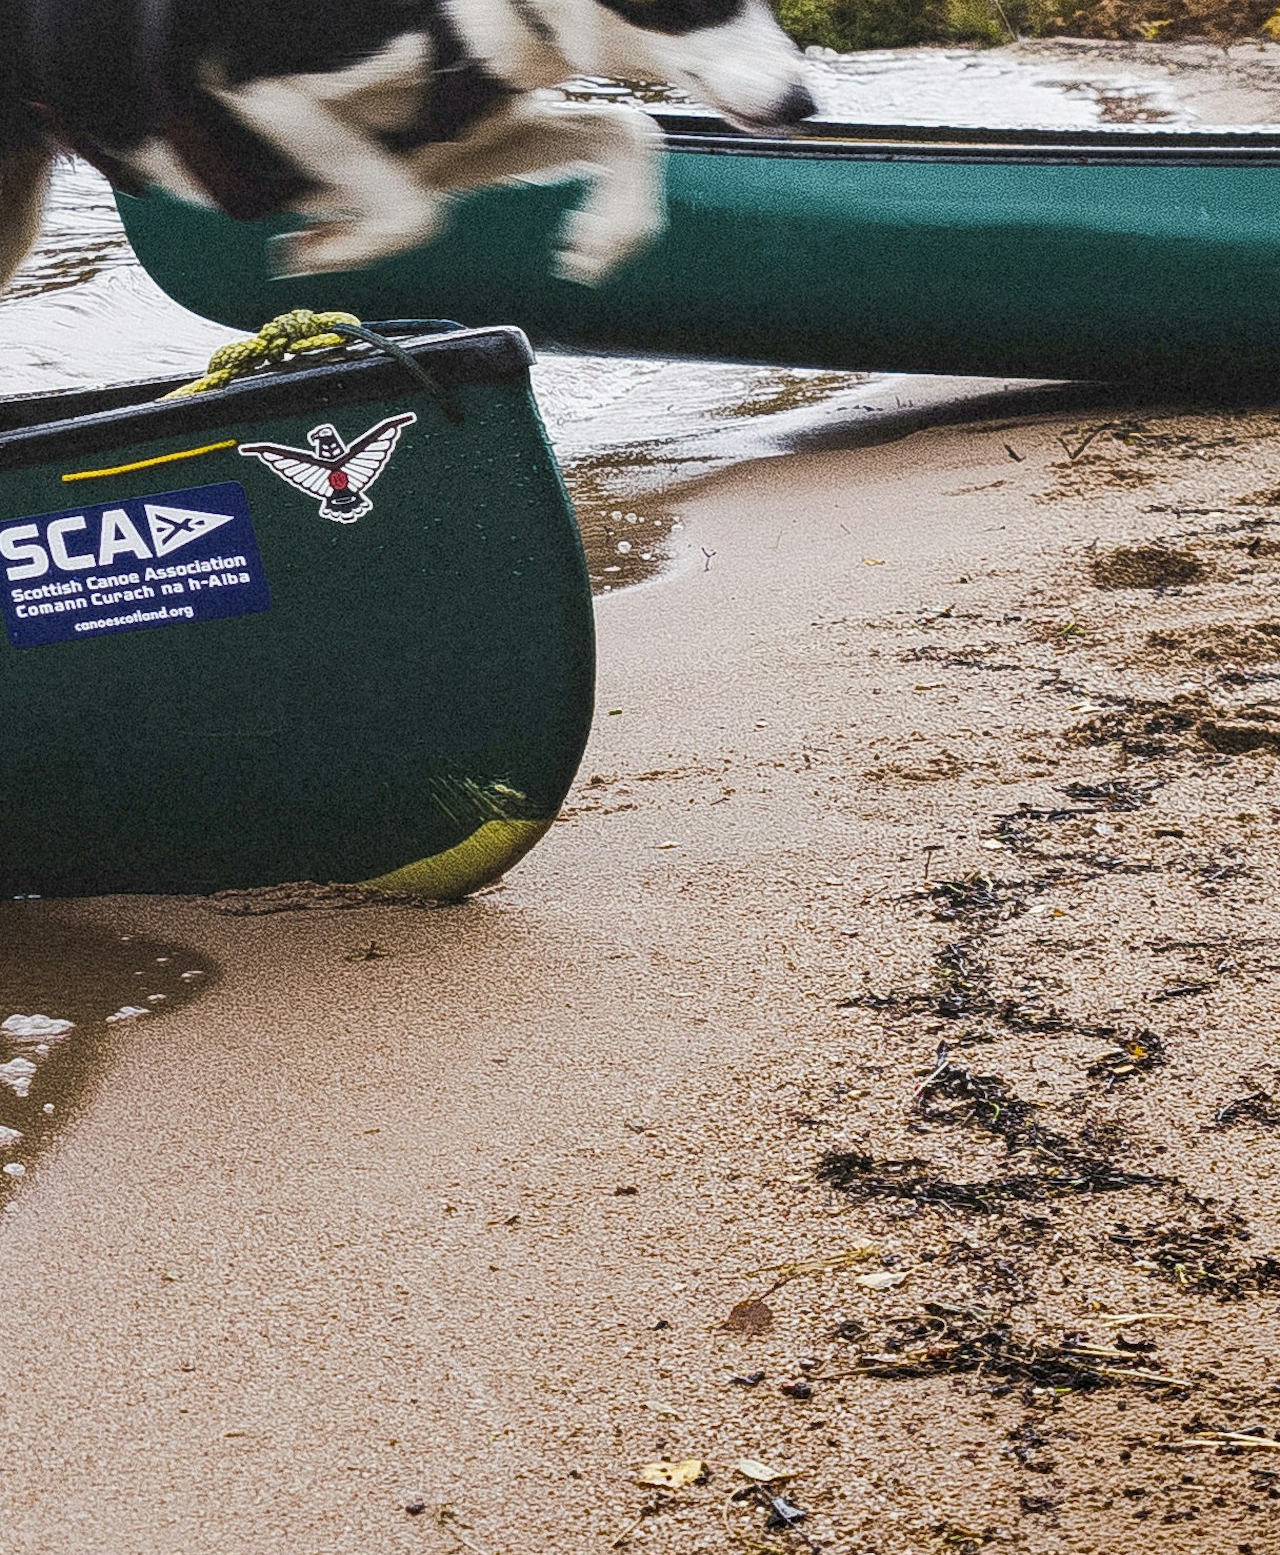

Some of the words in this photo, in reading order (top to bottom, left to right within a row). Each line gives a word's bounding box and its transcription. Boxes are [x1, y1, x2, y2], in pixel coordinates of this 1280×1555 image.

[11, 580, 83, 603] Scottish
[86, 572, 140, 591] Canoe
[144, 555, 247, 582] Association
[16, 597, 88, 618] Comann
[90, 585, 155, 606] Curach
[161, 581, 184, 596] na
[189, 571, 251, 591] h-Alba
[74, 605, 194, 632] canoescotland.org
